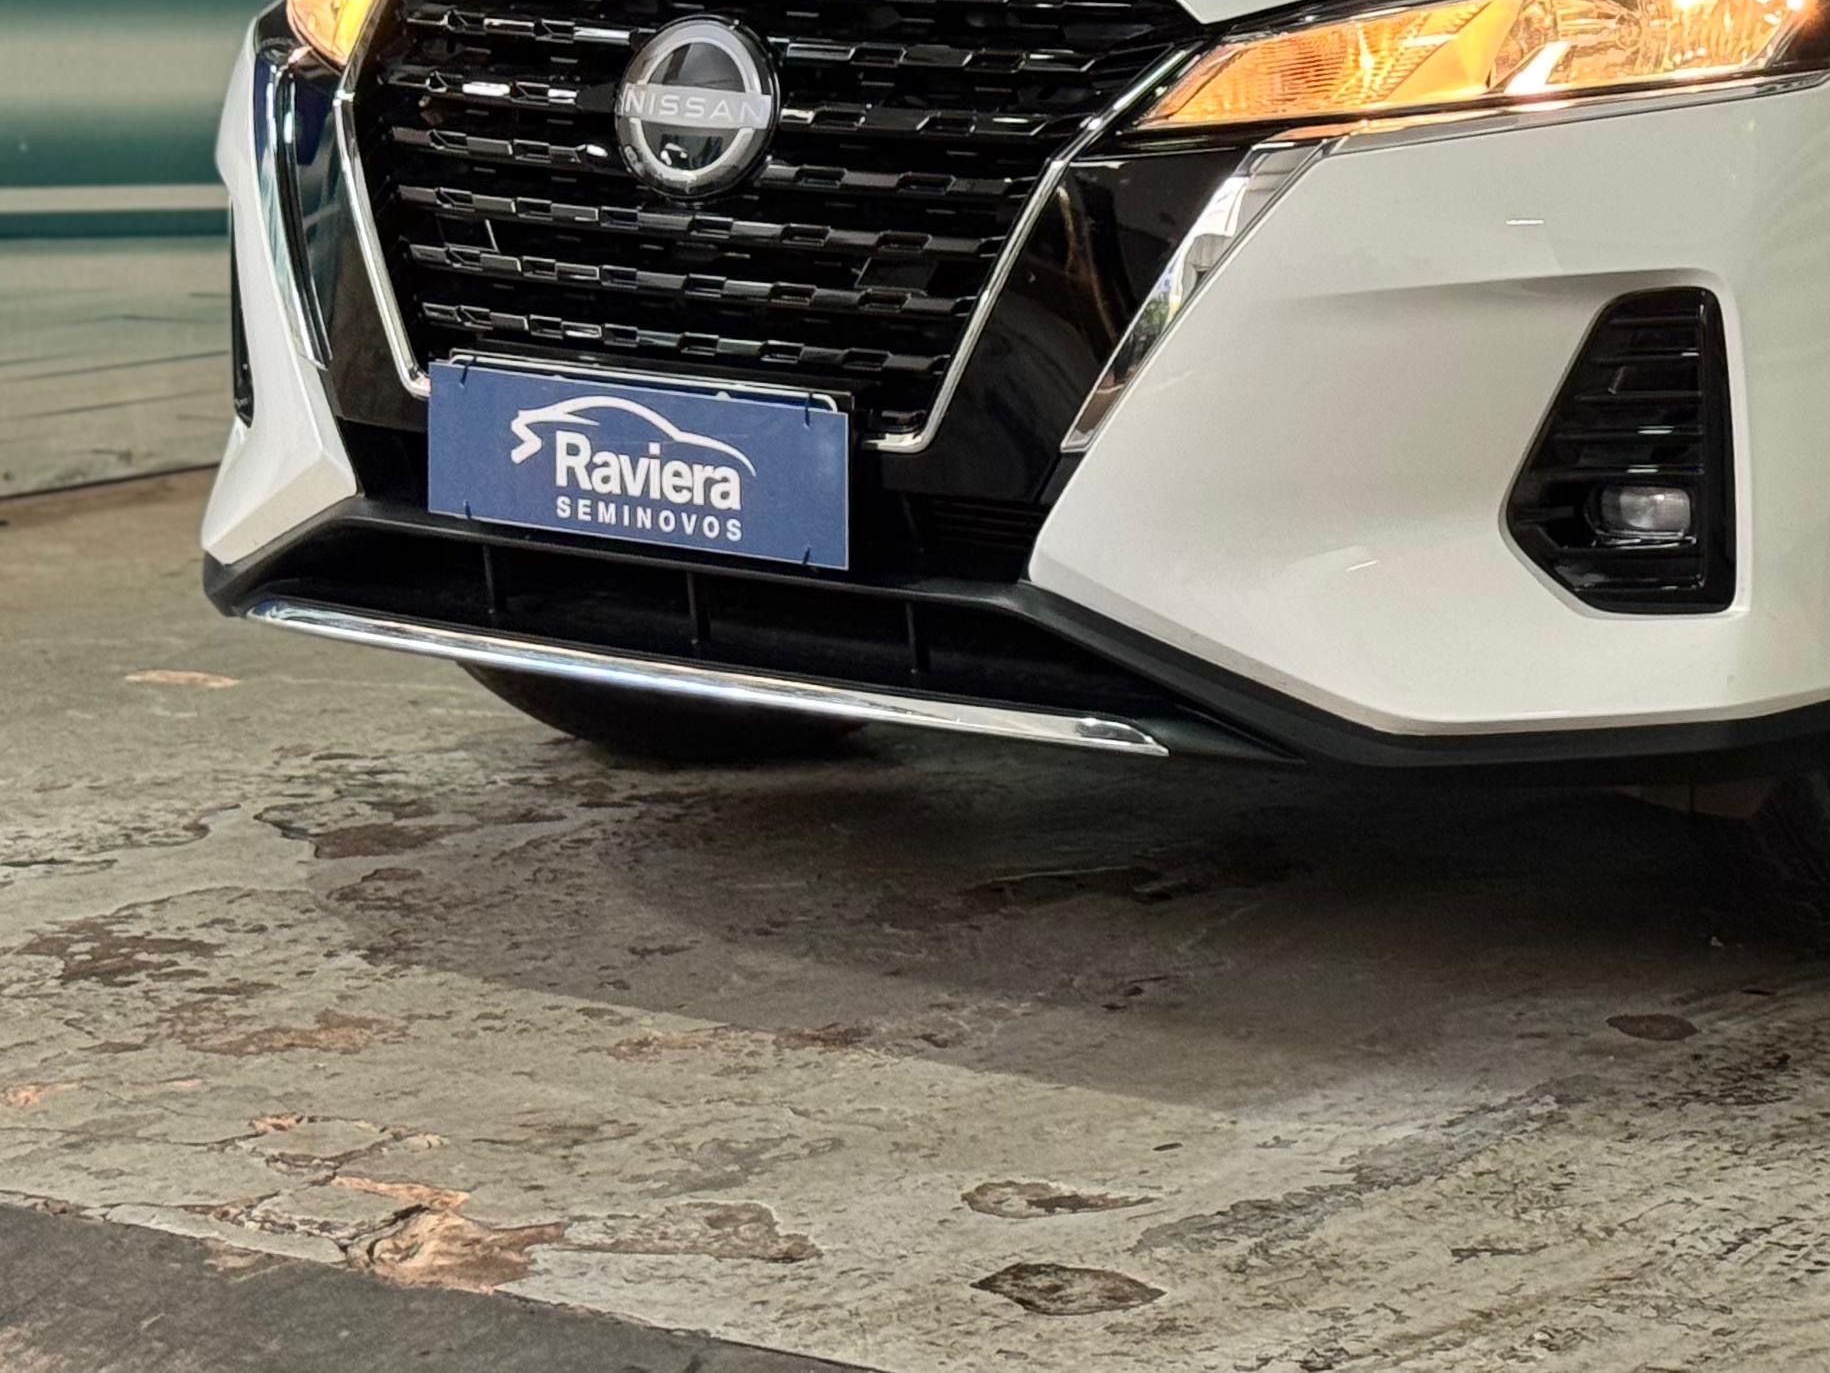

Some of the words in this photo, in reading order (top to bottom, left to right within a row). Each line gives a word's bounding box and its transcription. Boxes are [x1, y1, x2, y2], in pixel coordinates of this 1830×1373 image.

[624, 85, 765, 125] NISSAN
[555, 430, 742, 511] Raviera
[556, 495, 743, 542] SEMINOVOS
